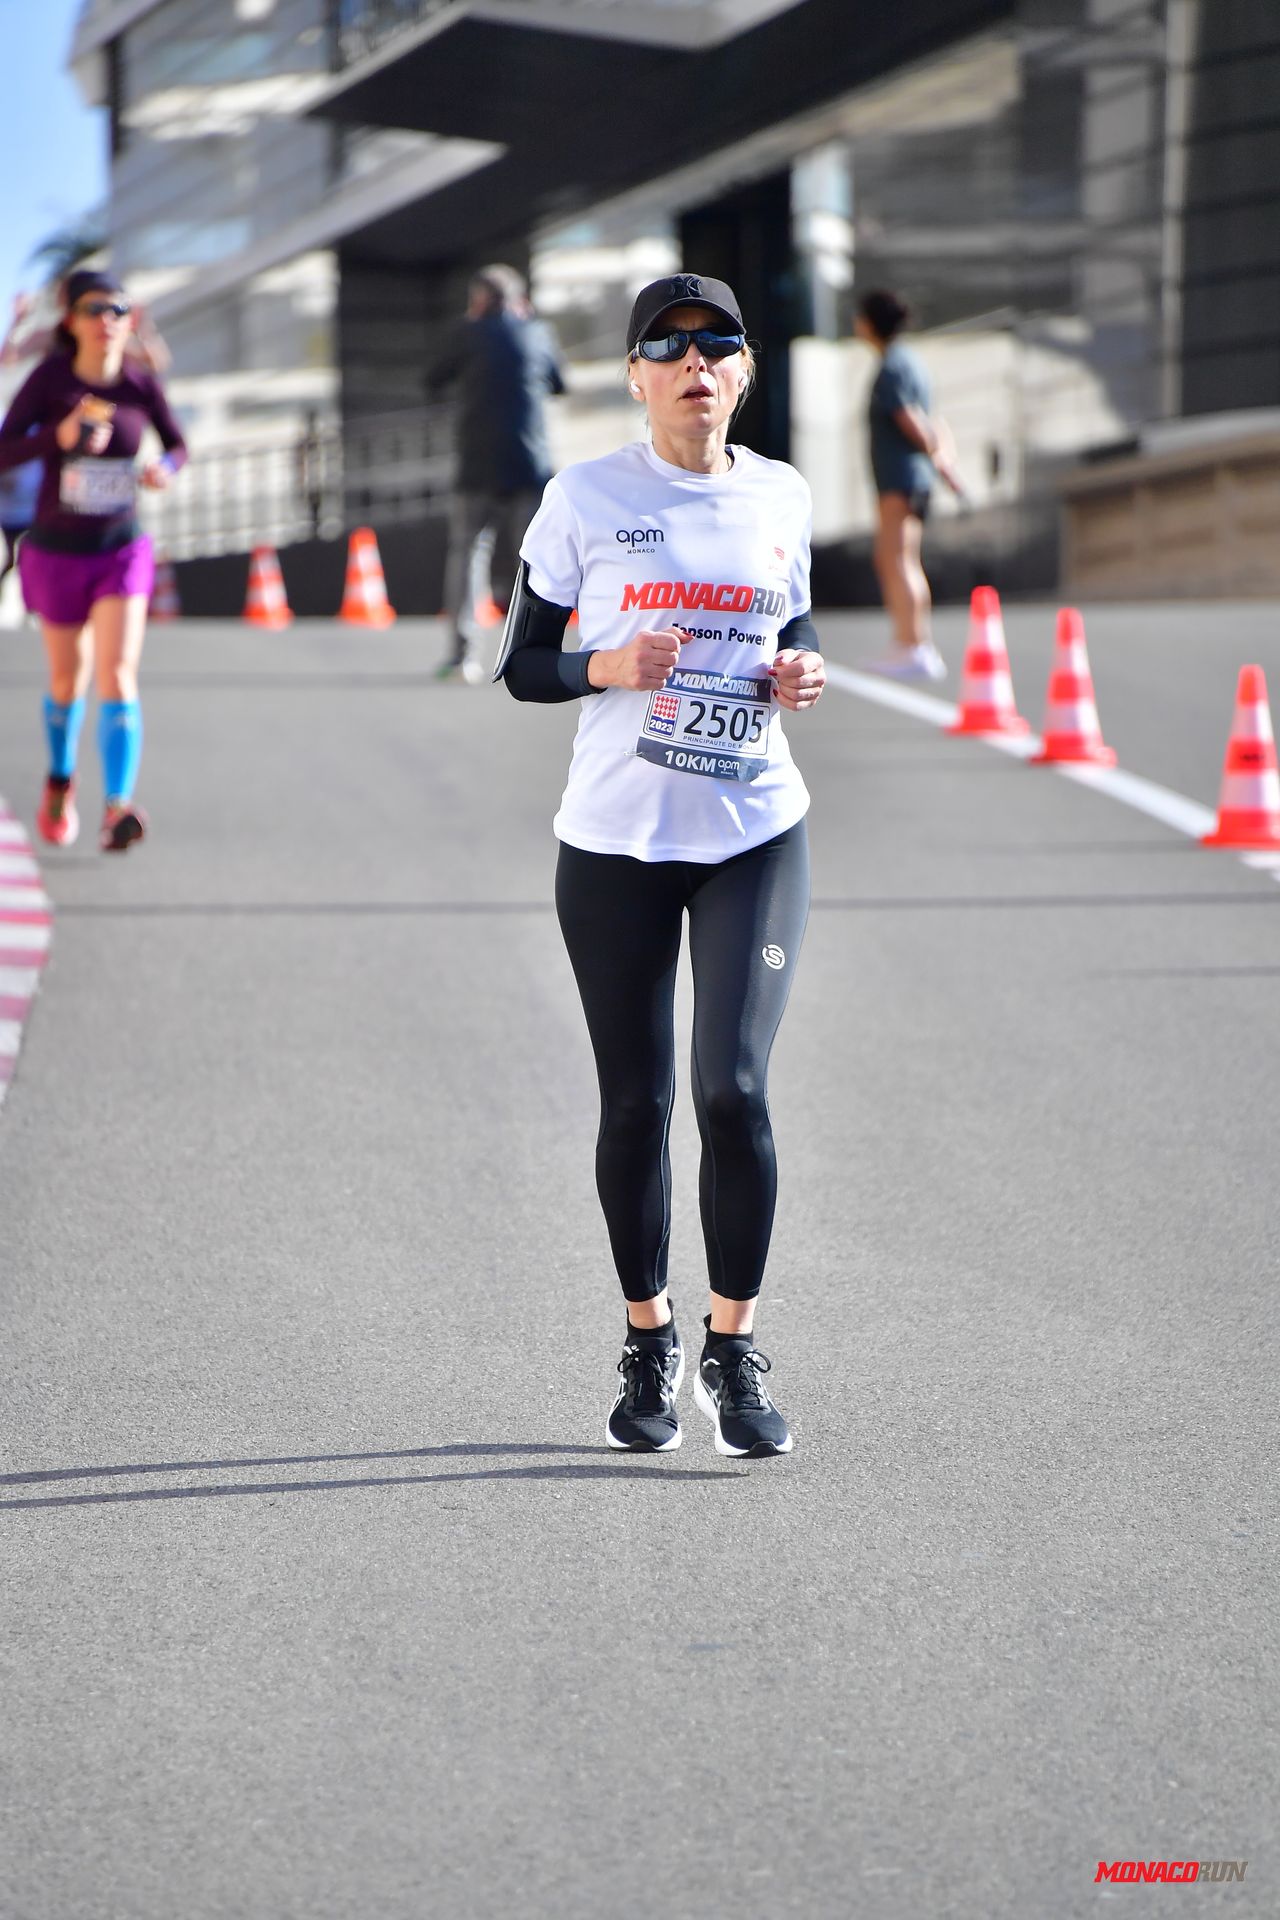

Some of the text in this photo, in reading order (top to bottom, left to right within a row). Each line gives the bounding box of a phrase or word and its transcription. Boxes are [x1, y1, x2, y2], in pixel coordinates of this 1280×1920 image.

[616, 529, 665, 547] apm
[672, 623, 766, 646] pson Power
[672, 672, 758, 697] MONACORUN
[650, 719, 674, 733] 2023
[683, 700, 765, 743] 2505
[665, 750, 717, 773] 10KM
[718, 759, 740, 771] apm
